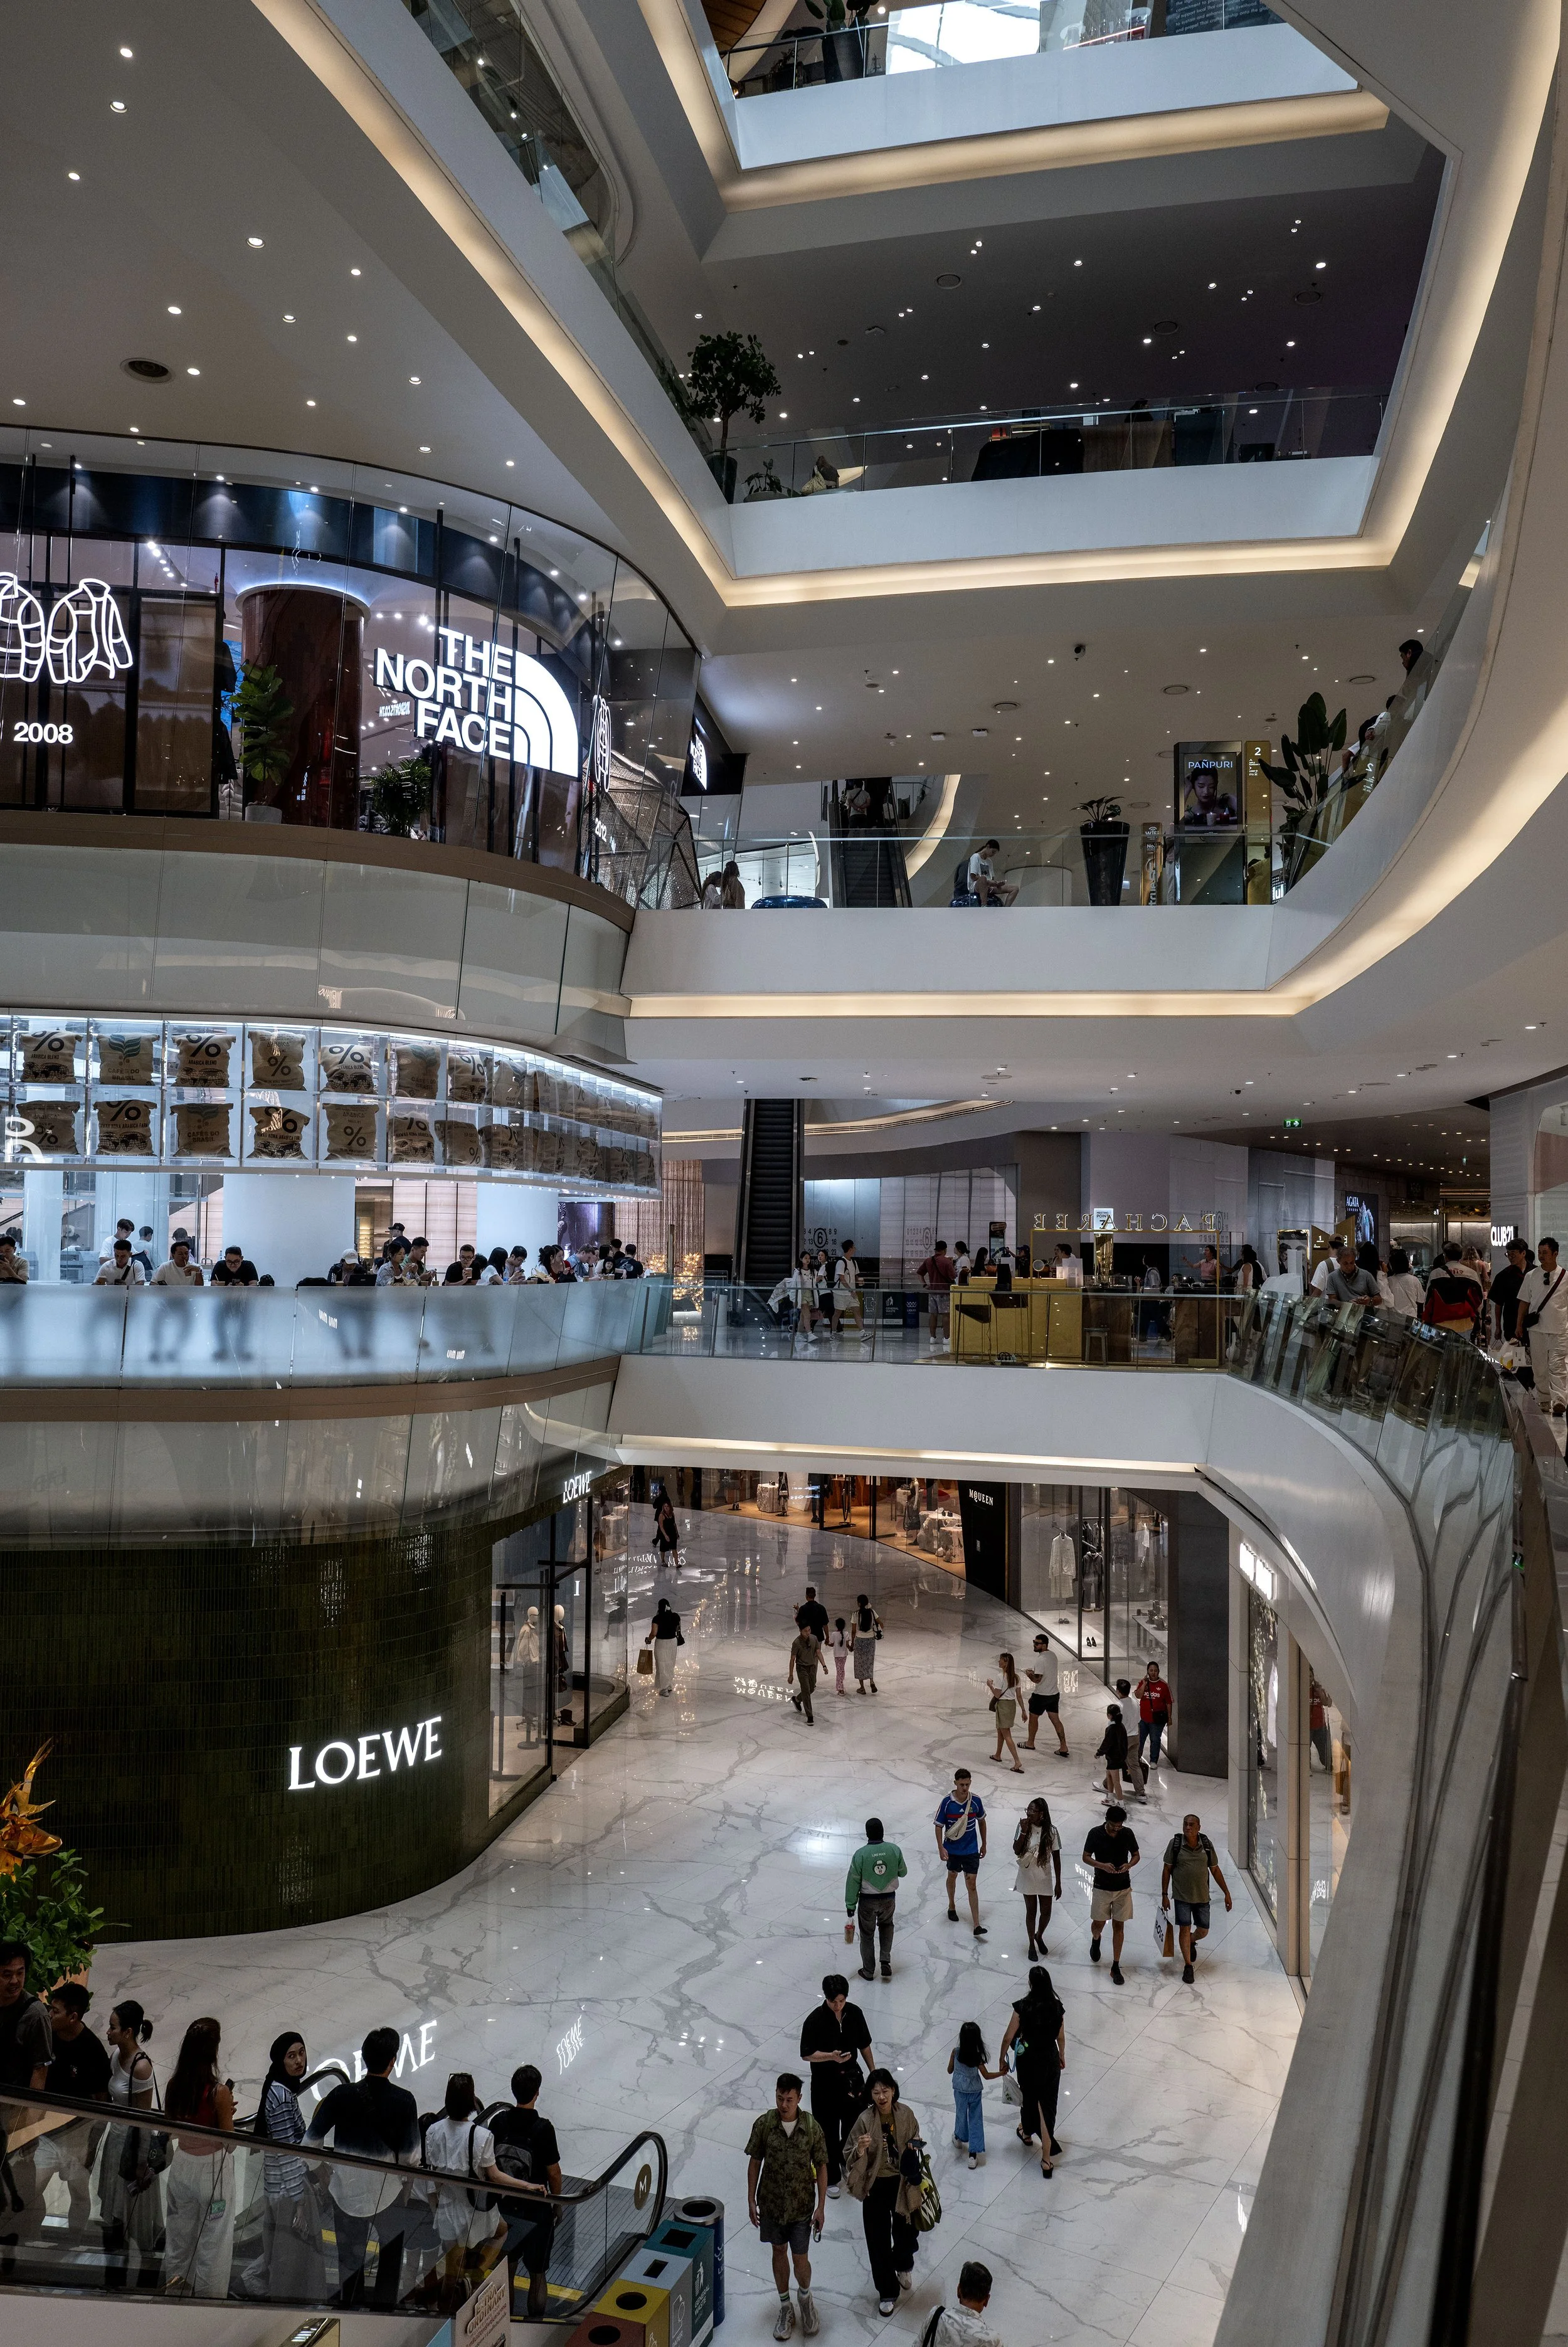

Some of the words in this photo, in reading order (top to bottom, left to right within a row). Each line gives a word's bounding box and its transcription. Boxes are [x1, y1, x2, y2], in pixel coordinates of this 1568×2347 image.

[1185, 22, 1199, 31] propel
[439, 626, 514, 684] THE
[376, 647, 512, 723] NORTH
[13, 721, 73, 744] 2008
[417, 699, 511, 760] FACE
[1254, 747, 1261, 756] 2
[1188, 759, 1234, 769] PAÑPURI
[595, 817, 607, 842] 2012
[1346, 1196, 1359, 1207] AGATA
[817, 1232, 824, 1244] 6
[288, 1716, 442, 1790] LOEWE
[694, 2284, 710, 2308] GENERAL
[694, 2295, 707, 2316] WASTE
[467, 2286, 506, 2334] ORDINARY
